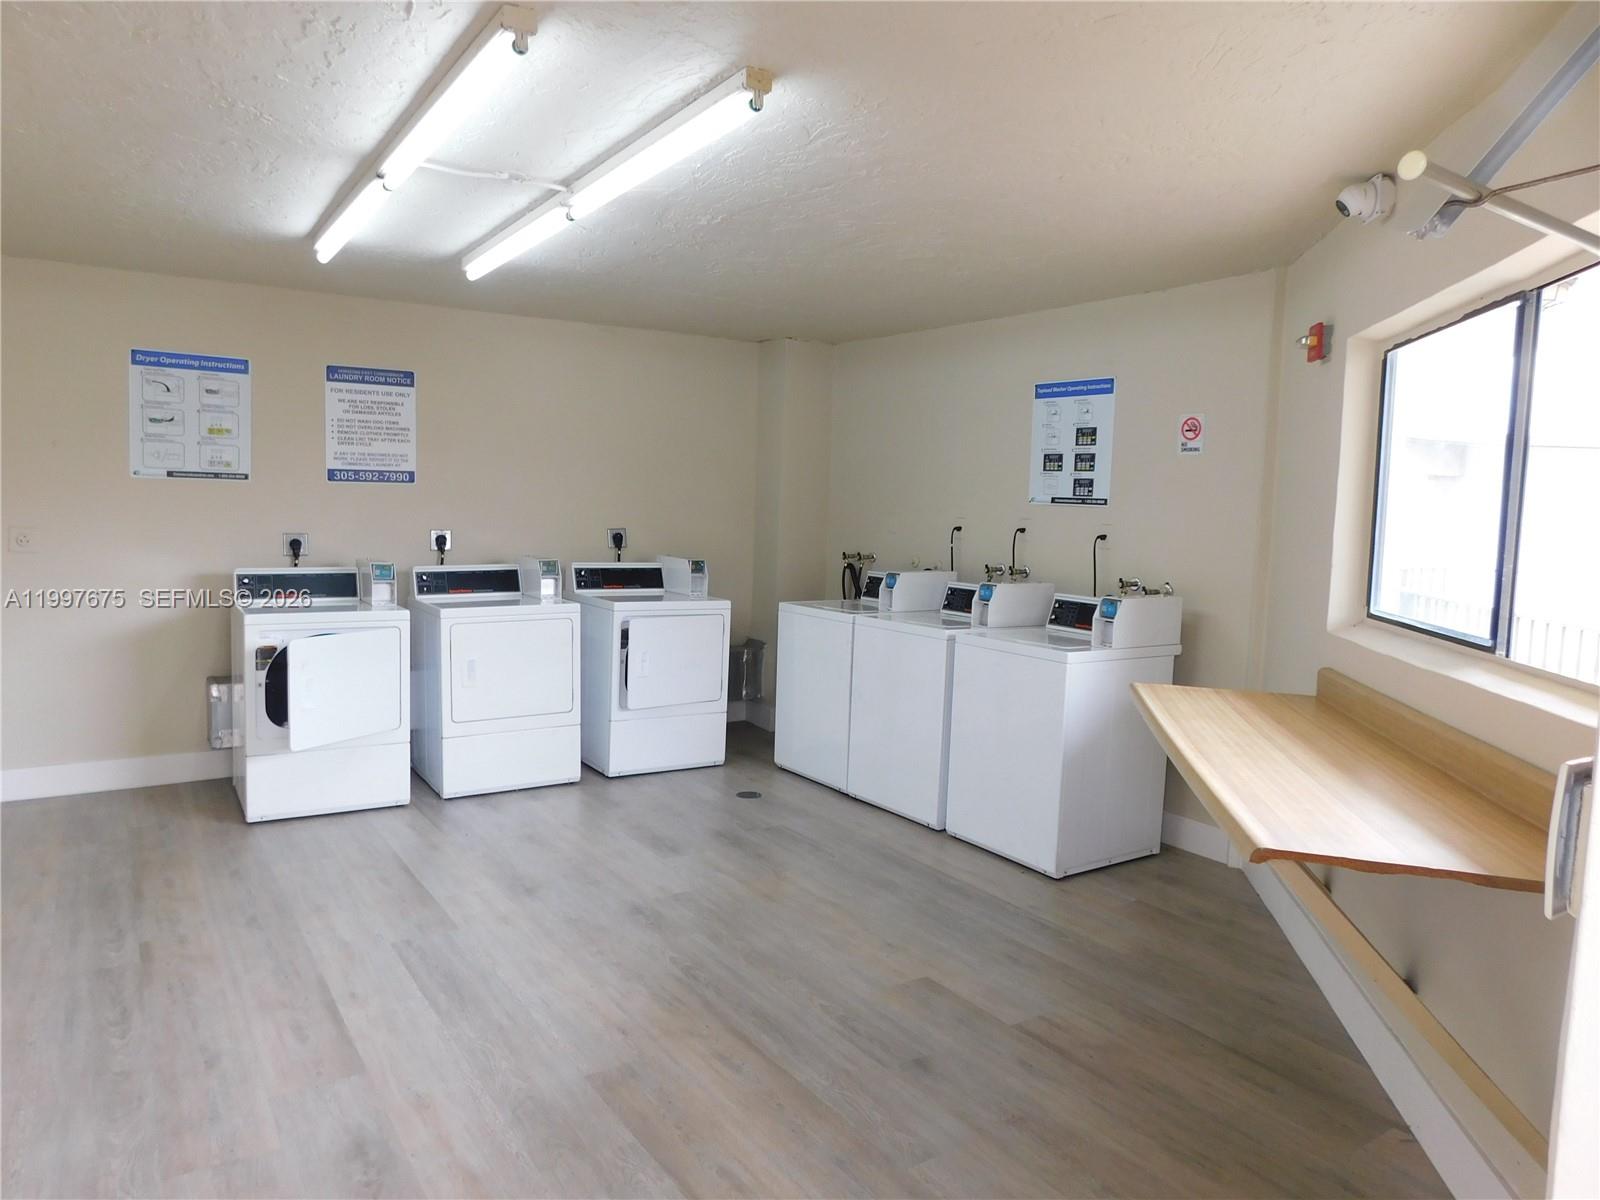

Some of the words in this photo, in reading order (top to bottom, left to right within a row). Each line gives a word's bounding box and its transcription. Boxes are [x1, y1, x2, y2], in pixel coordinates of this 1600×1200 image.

[136, 354, 158, 363] Dryer
[160, 357, 199, 367] Operating
[200, 360, 245, 370] Instructions
[329, 373, 363, 381] LAUNDRY
[364, 375, 386, 383] ROOM
[387, 377, 412, 385] NOTICE
[334, 470, 410, 481] 305-592-7990
